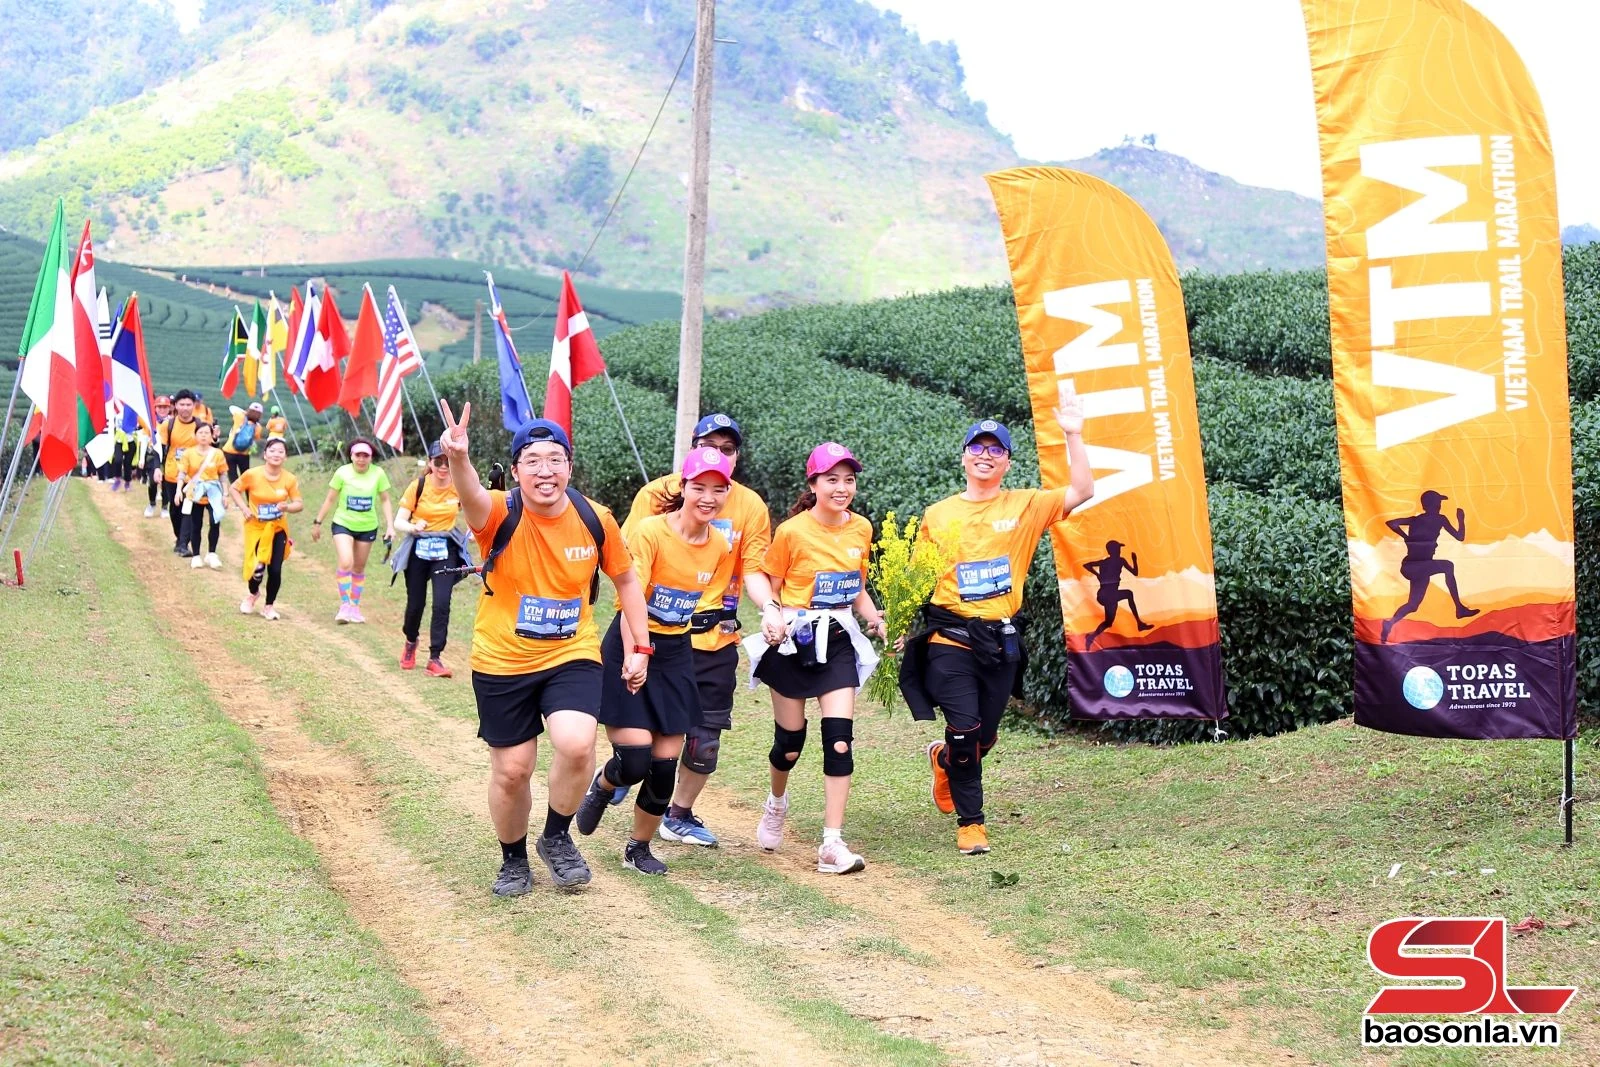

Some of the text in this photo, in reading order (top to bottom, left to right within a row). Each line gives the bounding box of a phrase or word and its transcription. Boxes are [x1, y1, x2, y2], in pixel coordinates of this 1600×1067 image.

[1489, 134, 1529, 412] VIETNAM TRAIL MARATHON
[1359, 134, 1497, 452] VTM
[1135, 278, 1176, 482] VIETNAM TRAIL MARATHON
[1042, 279, 1154, 515] VTM
[563, 545, 591, 560] VTM
[655, 593, 673, 604] VTM
[523, 604, 544, 614] VTM
[545, 607, 580, 619] M10649
[1135, 664, 1183, 676] TOPAS
[1446, 663, 1517, 681] TOPAS
[1136, 678, 1193, 690] TRAVEL
[1447, 682, 1531, 700] TRAVEL
